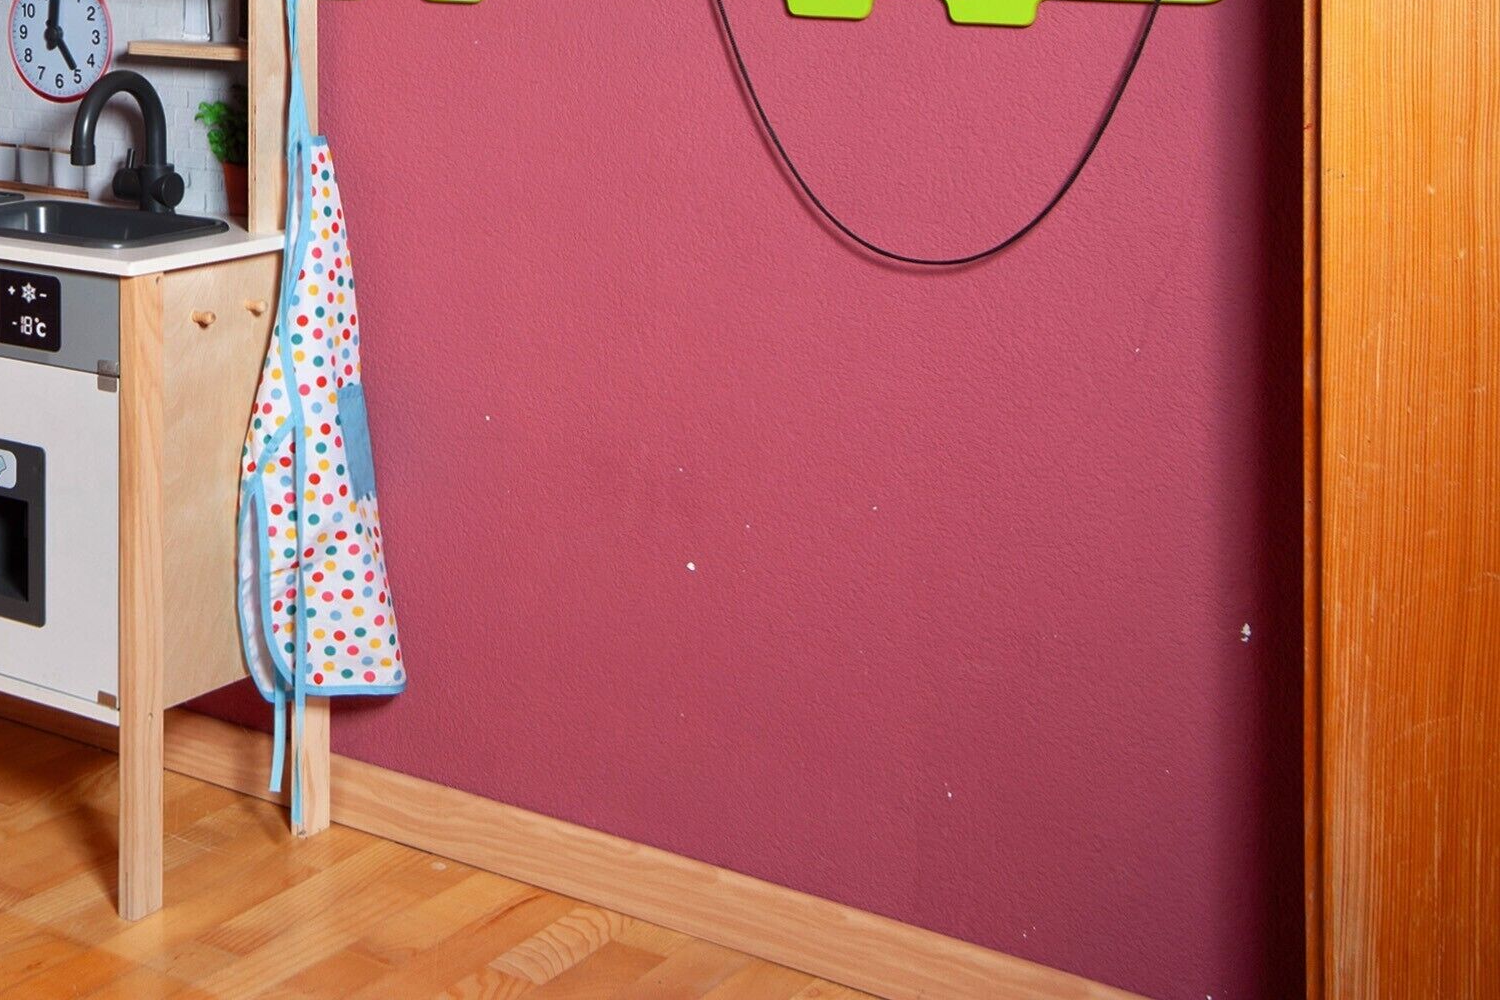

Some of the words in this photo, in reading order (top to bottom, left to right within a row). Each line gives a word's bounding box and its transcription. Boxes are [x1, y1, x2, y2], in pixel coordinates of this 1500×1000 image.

[21, 4, 36, 19] 10
[86, 6, 96, 21] 2
[19, 25, 28, 40] 9
[91, 30, 101, 45] 3
[24, 48, 33, 63] 8
[86, 54, 95, 68] 4
[37, 66, 46, 80] 7
[73, 69, 82, 84] 5
[55, 74, 64, 89] 6
